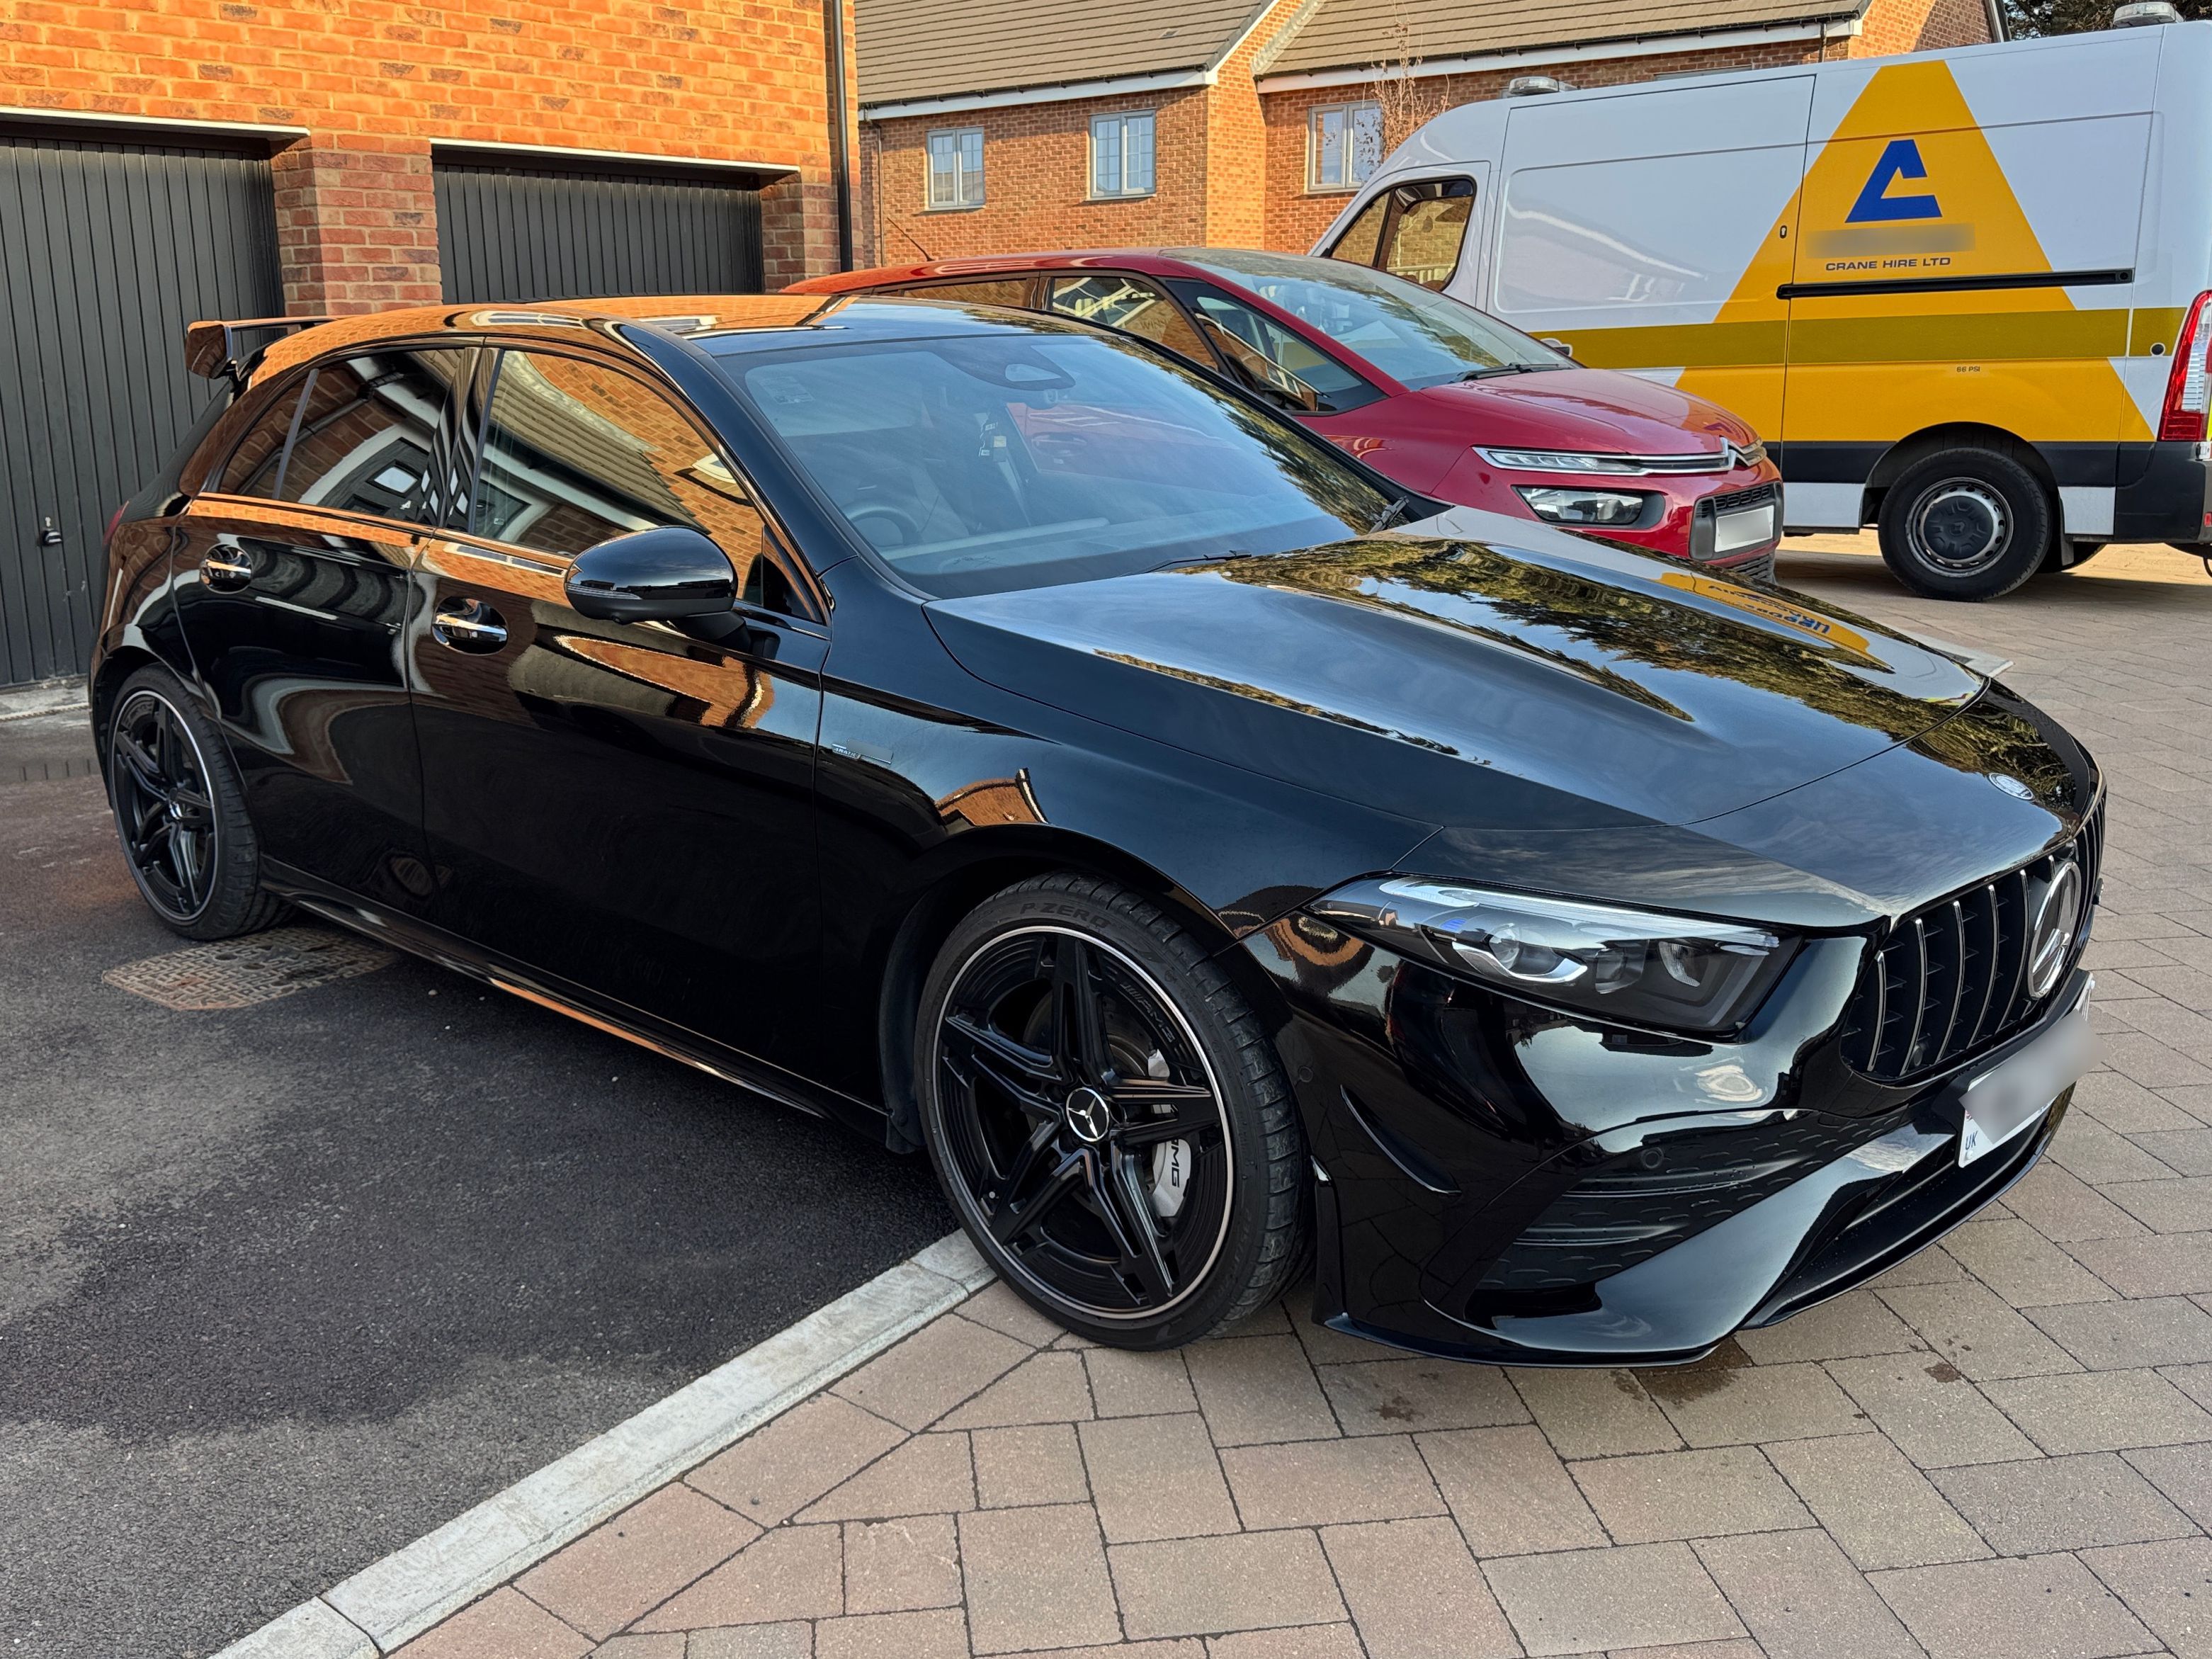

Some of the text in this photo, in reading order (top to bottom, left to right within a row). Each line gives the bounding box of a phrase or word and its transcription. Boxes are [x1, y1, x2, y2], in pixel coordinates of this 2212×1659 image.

[1825, 257, 1951, 271] CRANE HIRE LTD
[1965, 1130, 1978, 1150] UK
